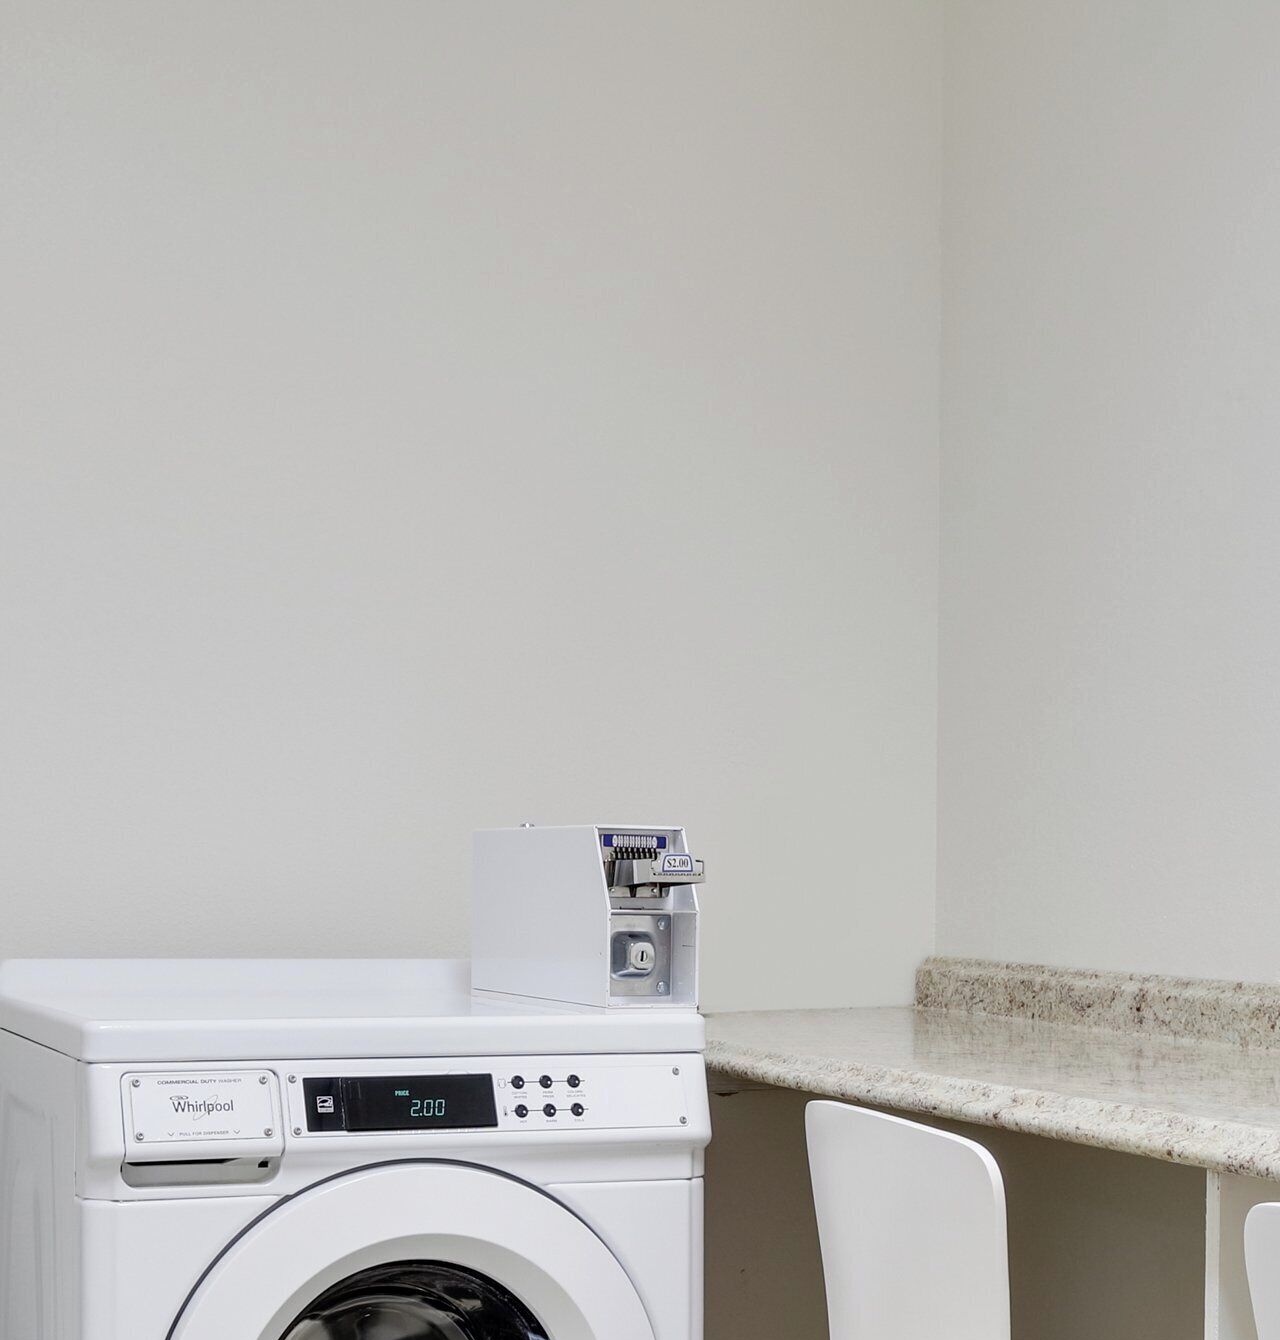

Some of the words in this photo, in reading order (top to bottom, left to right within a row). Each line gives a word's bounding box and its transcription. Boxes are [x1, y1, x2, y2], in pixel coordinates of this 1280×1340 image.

[666, 858, 689, 868] $2.00
[394, 1089, 410, 1097] PRICE
[172, 1099, 234, 1116] Whirlpool
[410, 1099, 445, 1117] 2.00
